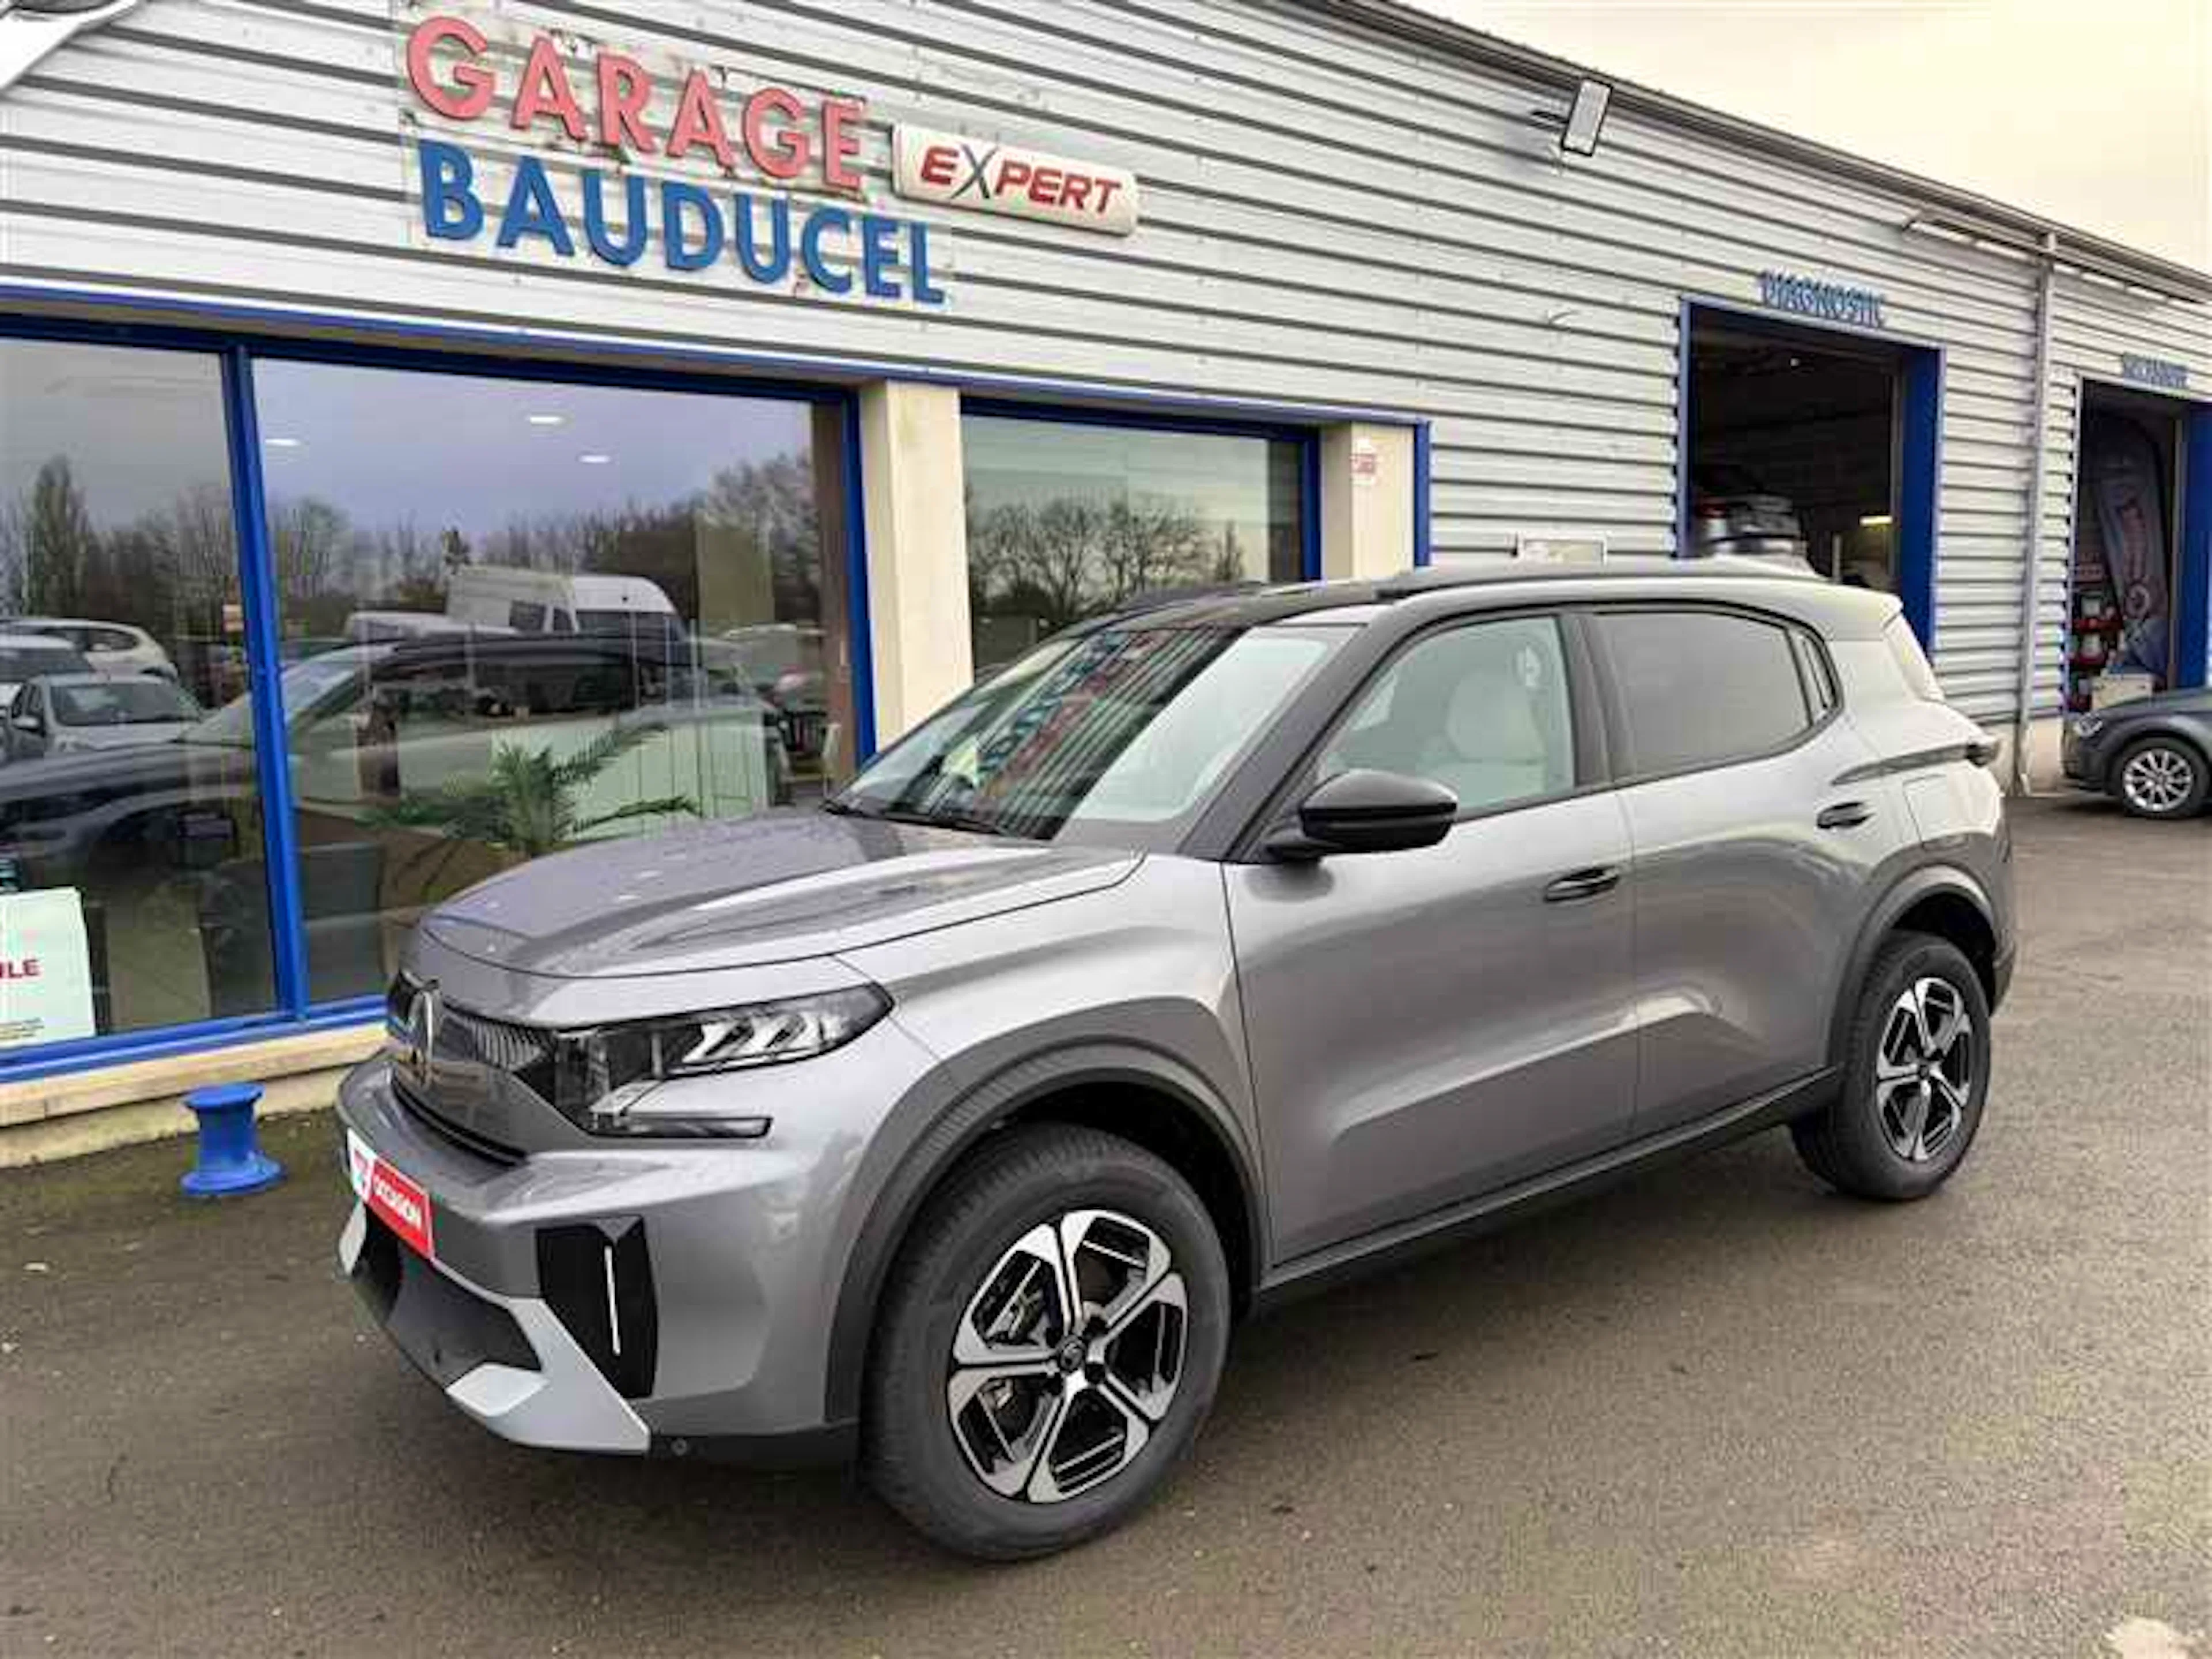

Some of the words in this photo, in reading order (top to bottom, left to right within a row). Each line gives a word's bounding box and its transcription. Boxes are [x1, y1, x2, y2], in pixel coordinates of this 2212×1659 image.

[406, 16, 865, 191] GARAGE
[921, 144, 1121, 215] EXPERT
[418, 138, 946, 305] BAUDUCEL
